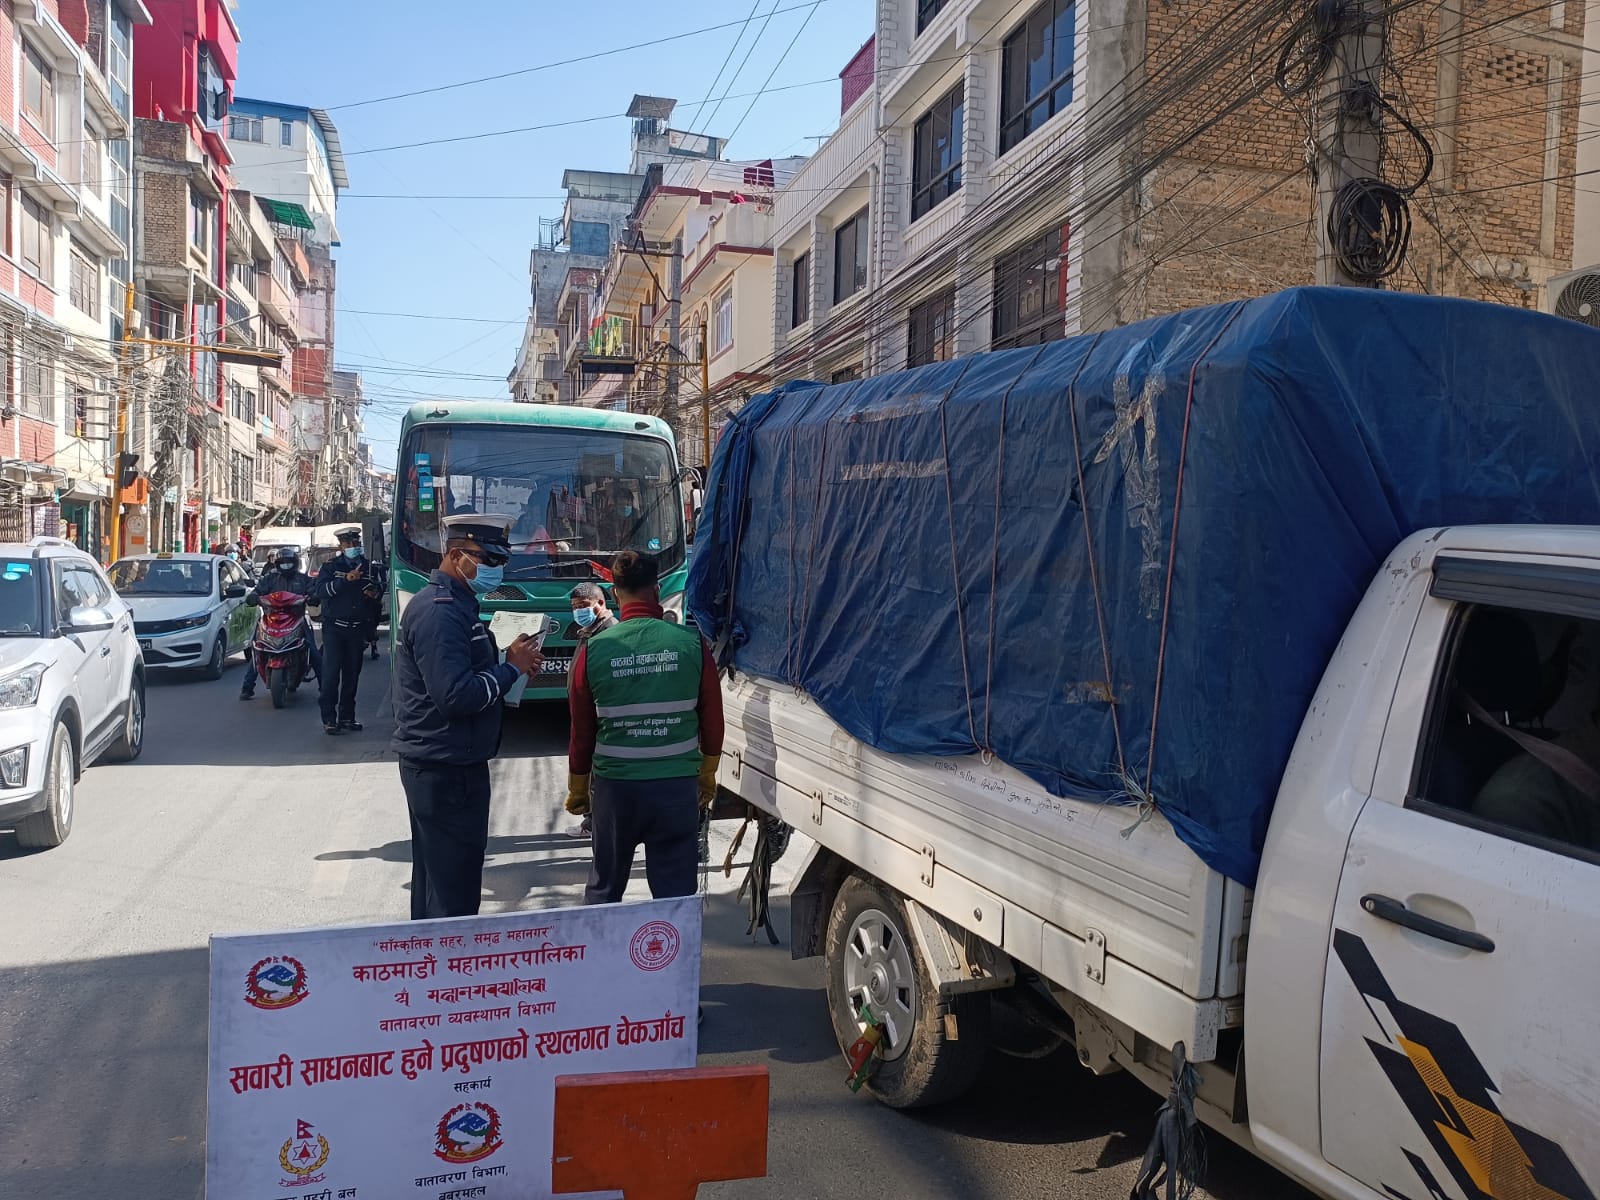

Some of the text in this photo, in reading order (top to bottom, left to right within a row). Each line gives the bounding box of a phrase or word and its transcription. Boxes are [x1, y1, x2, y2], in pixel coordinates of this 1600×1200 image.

[352, 942, 586, 983] काठमाडौं महानगरपालिका
[379, 1001, 557, 1032] वातावरण व्यवस्थापन विभाग
[229, 1009, 686, 1094] सवारी साधनबाट हुने प्रदुषणको स्थलगत चेकजाँच
[453, 1076, 493, 1094] सहकार्य
[415, 1165, 509, 1187] वातावरण विभाग,
[338, 1188, 357, 1199] बल
